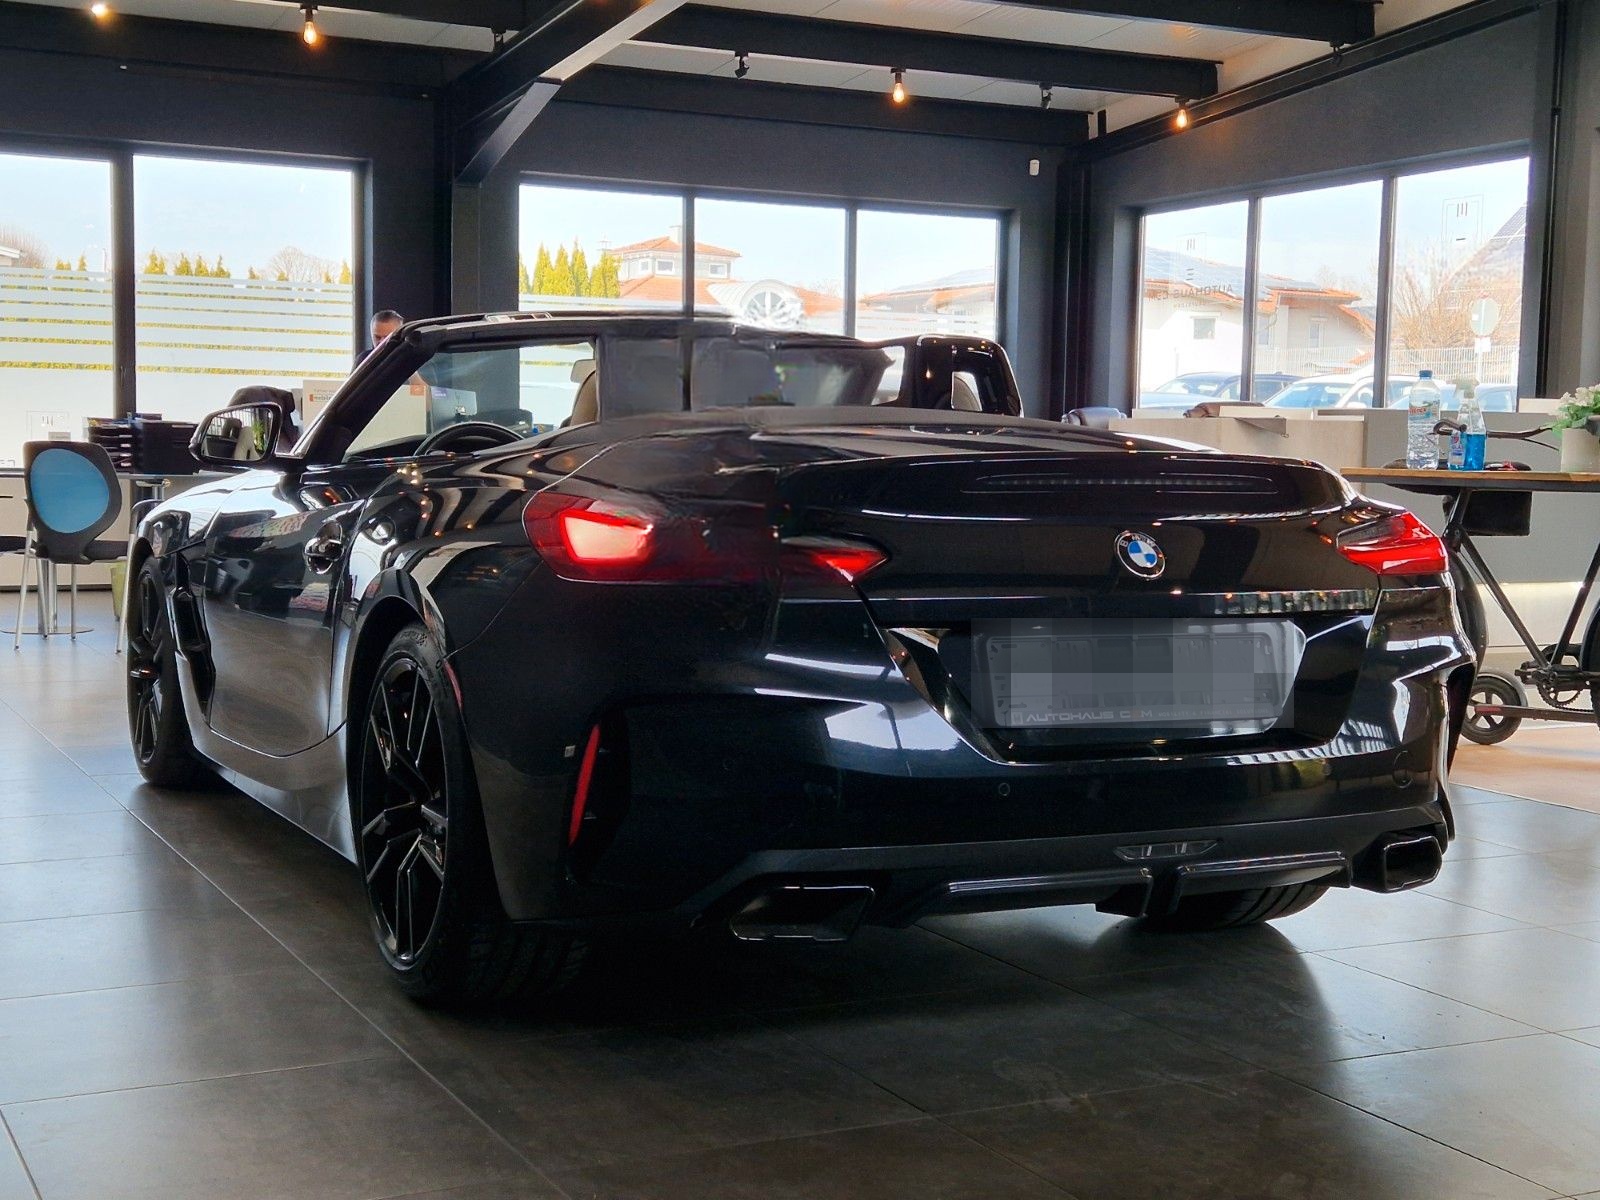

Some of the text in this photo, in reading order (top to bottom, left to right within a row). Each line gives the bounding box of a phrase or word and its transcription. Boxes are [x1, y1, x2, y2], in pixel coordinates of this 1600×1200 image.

[1120, 534, 1156, 547] BMW
[1026, 710, 1114, 722] AUTOHAUS
[1119, 709, 1153, 719] CM
